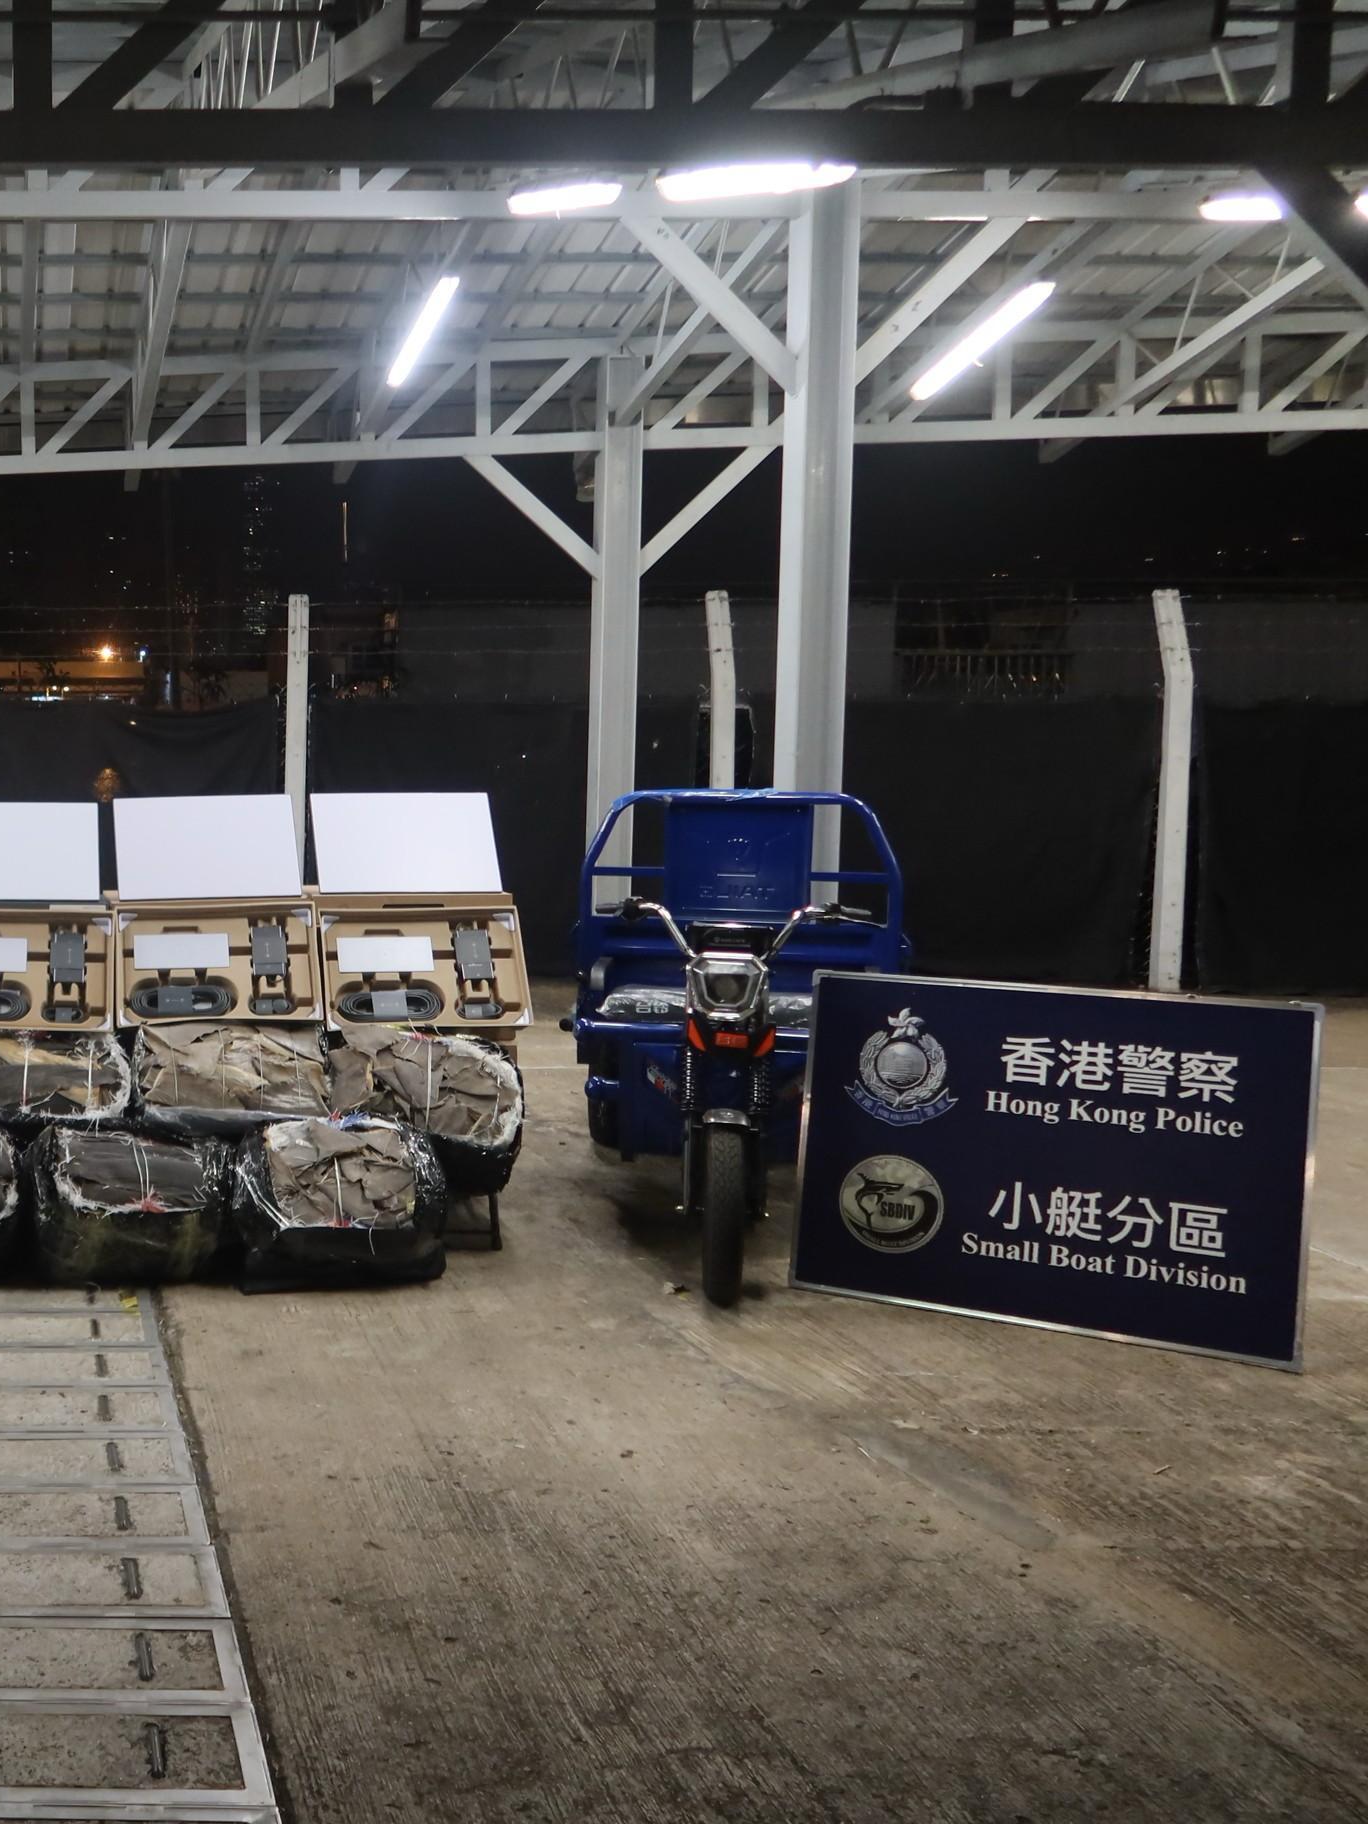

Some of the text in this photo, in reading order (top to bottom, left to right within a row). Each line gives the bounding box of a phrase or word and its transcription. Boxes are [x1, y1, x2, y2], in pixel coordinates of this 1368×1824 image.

[1000, 1036, 1239, 1104] 香港警察
[985, 1090, 1061, 1124] Hong
[1068, 1098, 1147, 1134] Kong
[1155, 1108, 1244, 1138] Police
[880, 1201, 916, 1220] SBDIV
[988, 1181, 1229, 1258] 小艇分區
[961, 1232, 1039, 1264] Small
[1049, 1244, 1115, 1275] Boat
[1124, 1256, 1246, 1294] Division
